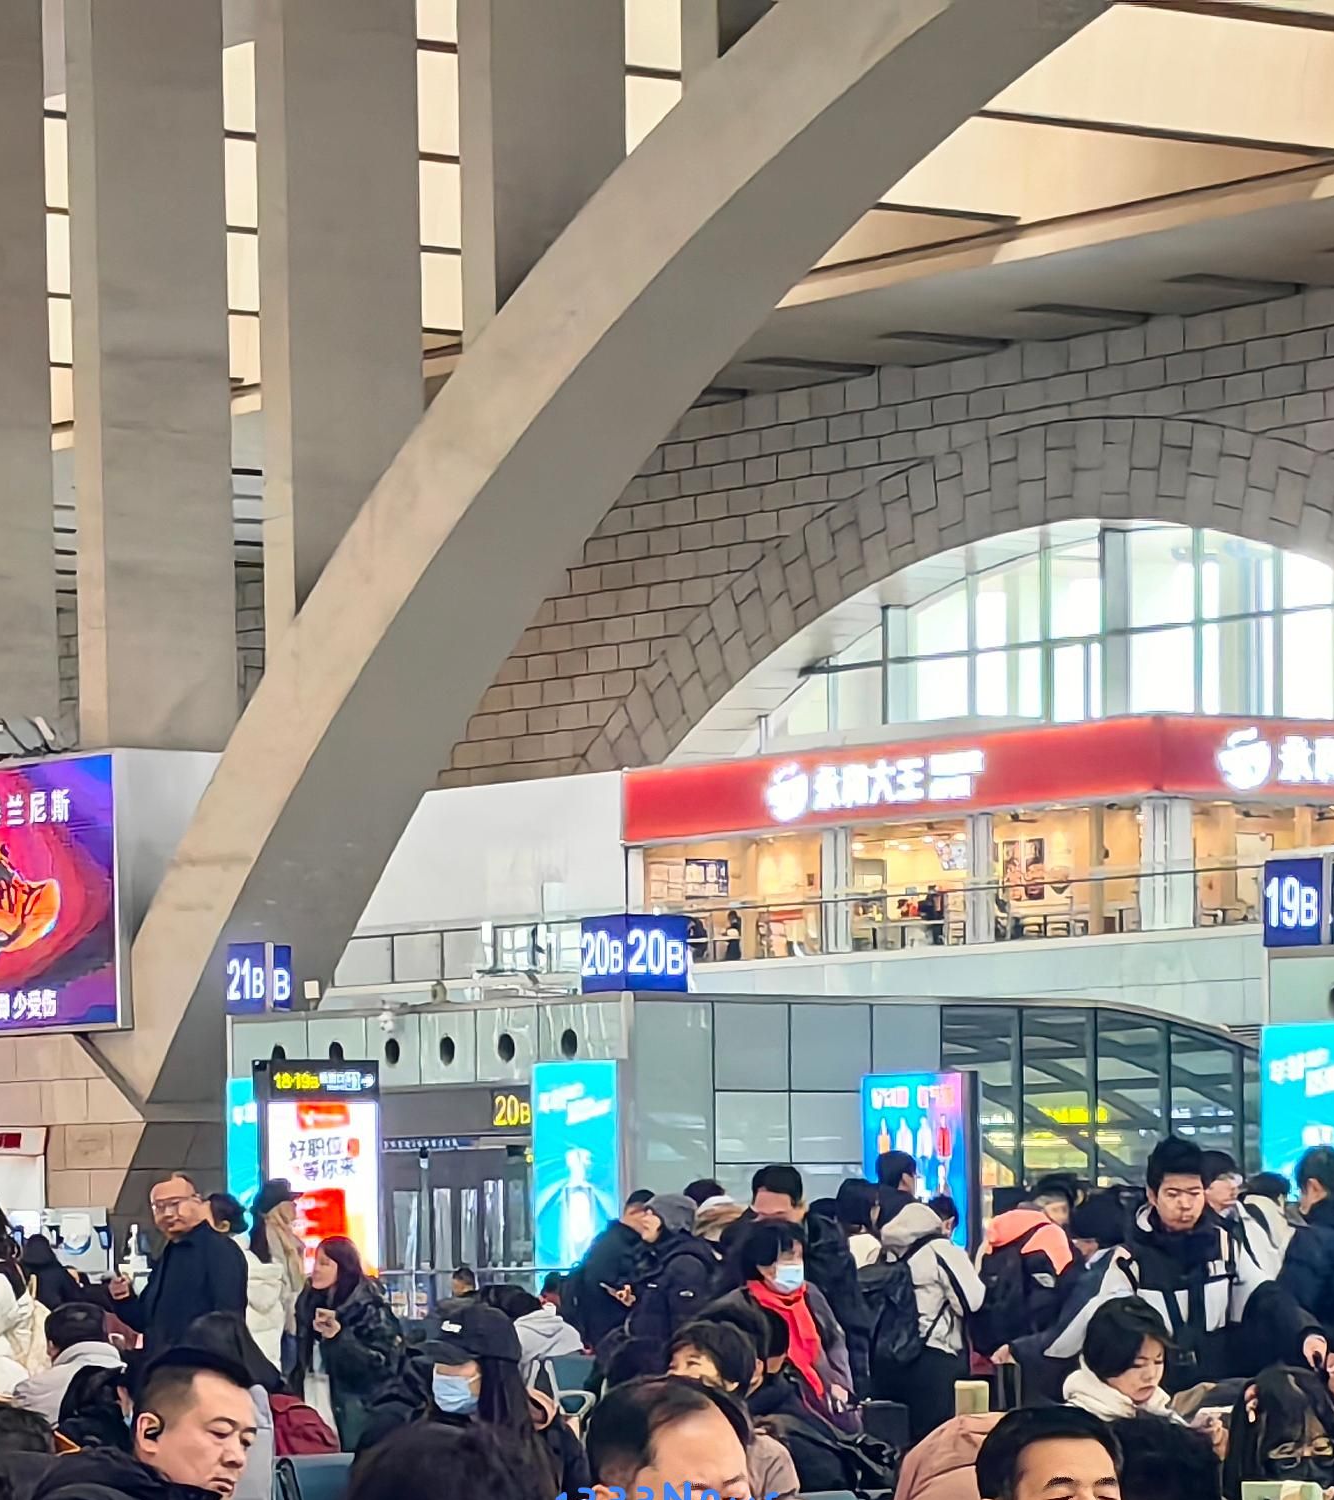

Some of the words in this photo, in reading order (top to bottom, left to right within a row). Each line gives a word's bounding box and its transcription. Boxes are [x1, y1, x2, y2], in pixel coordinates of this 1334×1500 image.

[1265, 876, 1318, 928] 19B
[581, 930, 624, 976] 20B
[627, 929, 684, 976] 20B
[227, 957, 265, 1001] 21B
[493, 1094, 531, 1126] 20B
